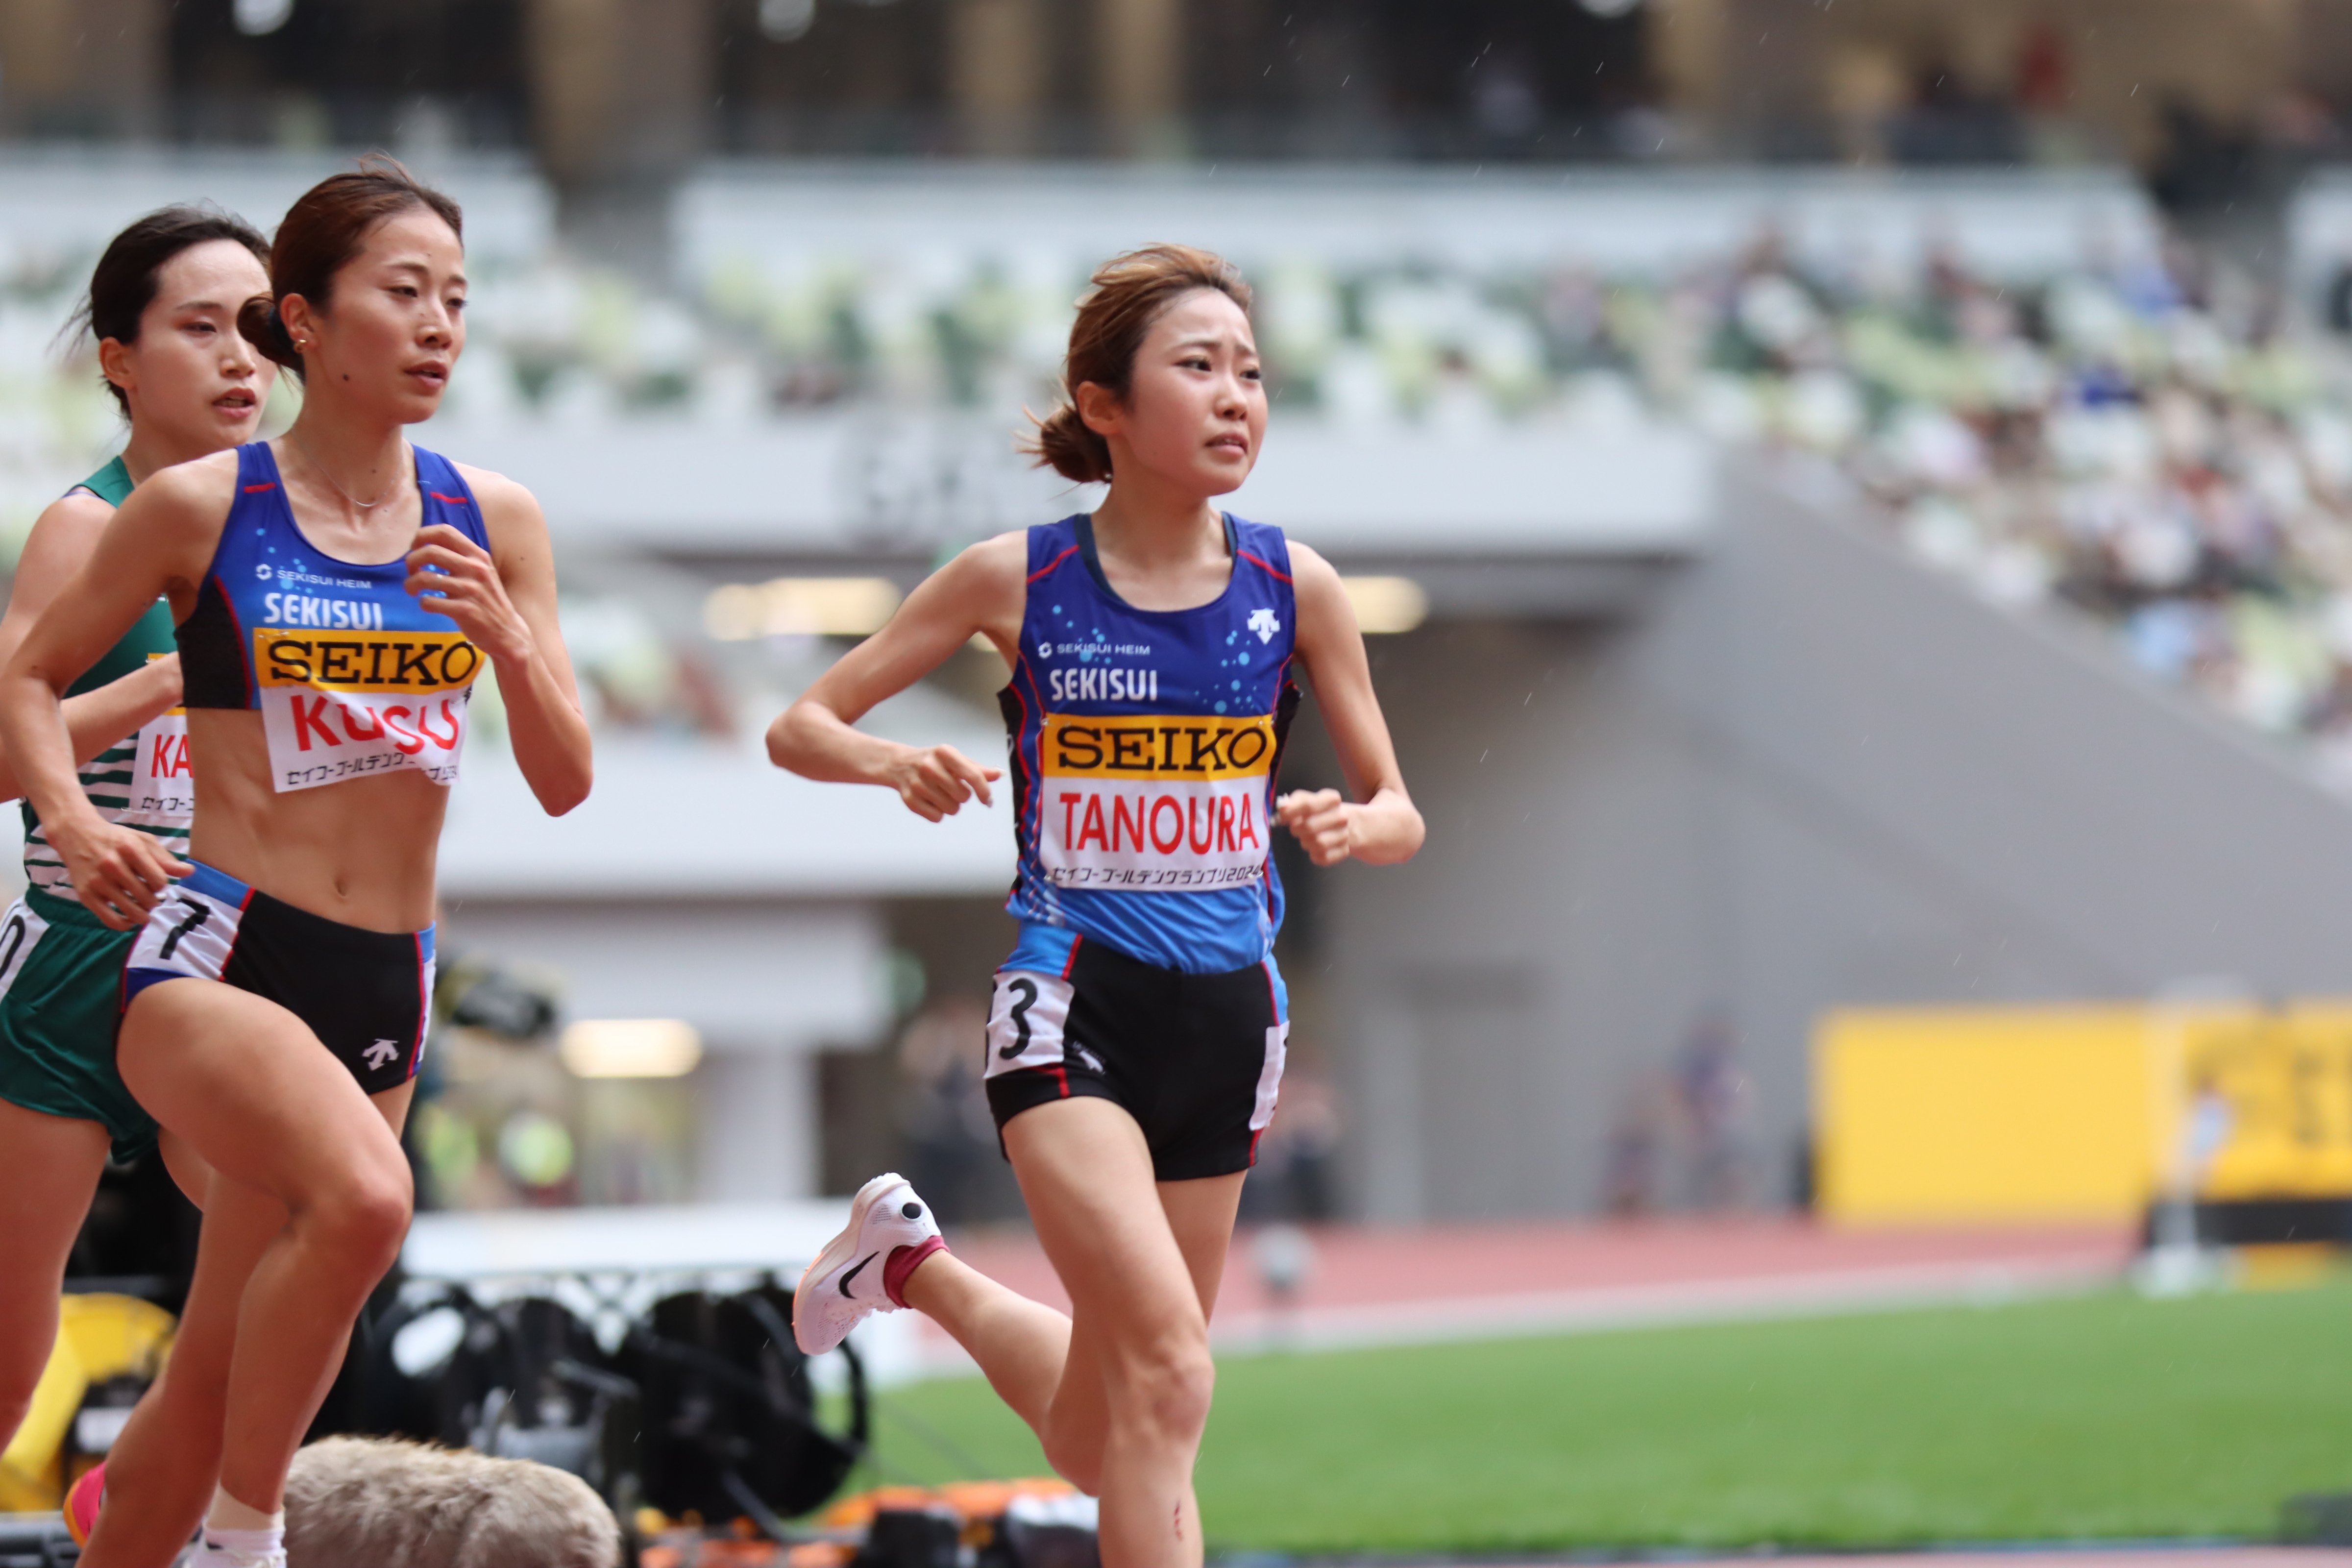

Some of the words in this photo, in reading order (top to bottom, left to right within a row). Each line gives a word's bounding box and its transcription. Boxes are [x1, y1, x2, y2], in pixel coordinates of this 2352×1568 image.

[276, 569, 333, 586] SEKISUI
[336, 578, 371, 588] HEIM
[264, 592, 383, 631] SEKISUI
[268, 639, 477, 686] SEIKO
[1057, 643, 1112, 654] SEKISUI
[1114, 644, 1151, 655] HEIM
[1050, 667, 1157, 701] SEKISUI
[290, 694, 459, 755] KUSU
[1056, 726, 1267, 772] SEIKO
[1059, 793, 1260, 855] TANOURA
[159, 897, 210, 960] 7
[999, 978, 1038, 1060] 3
